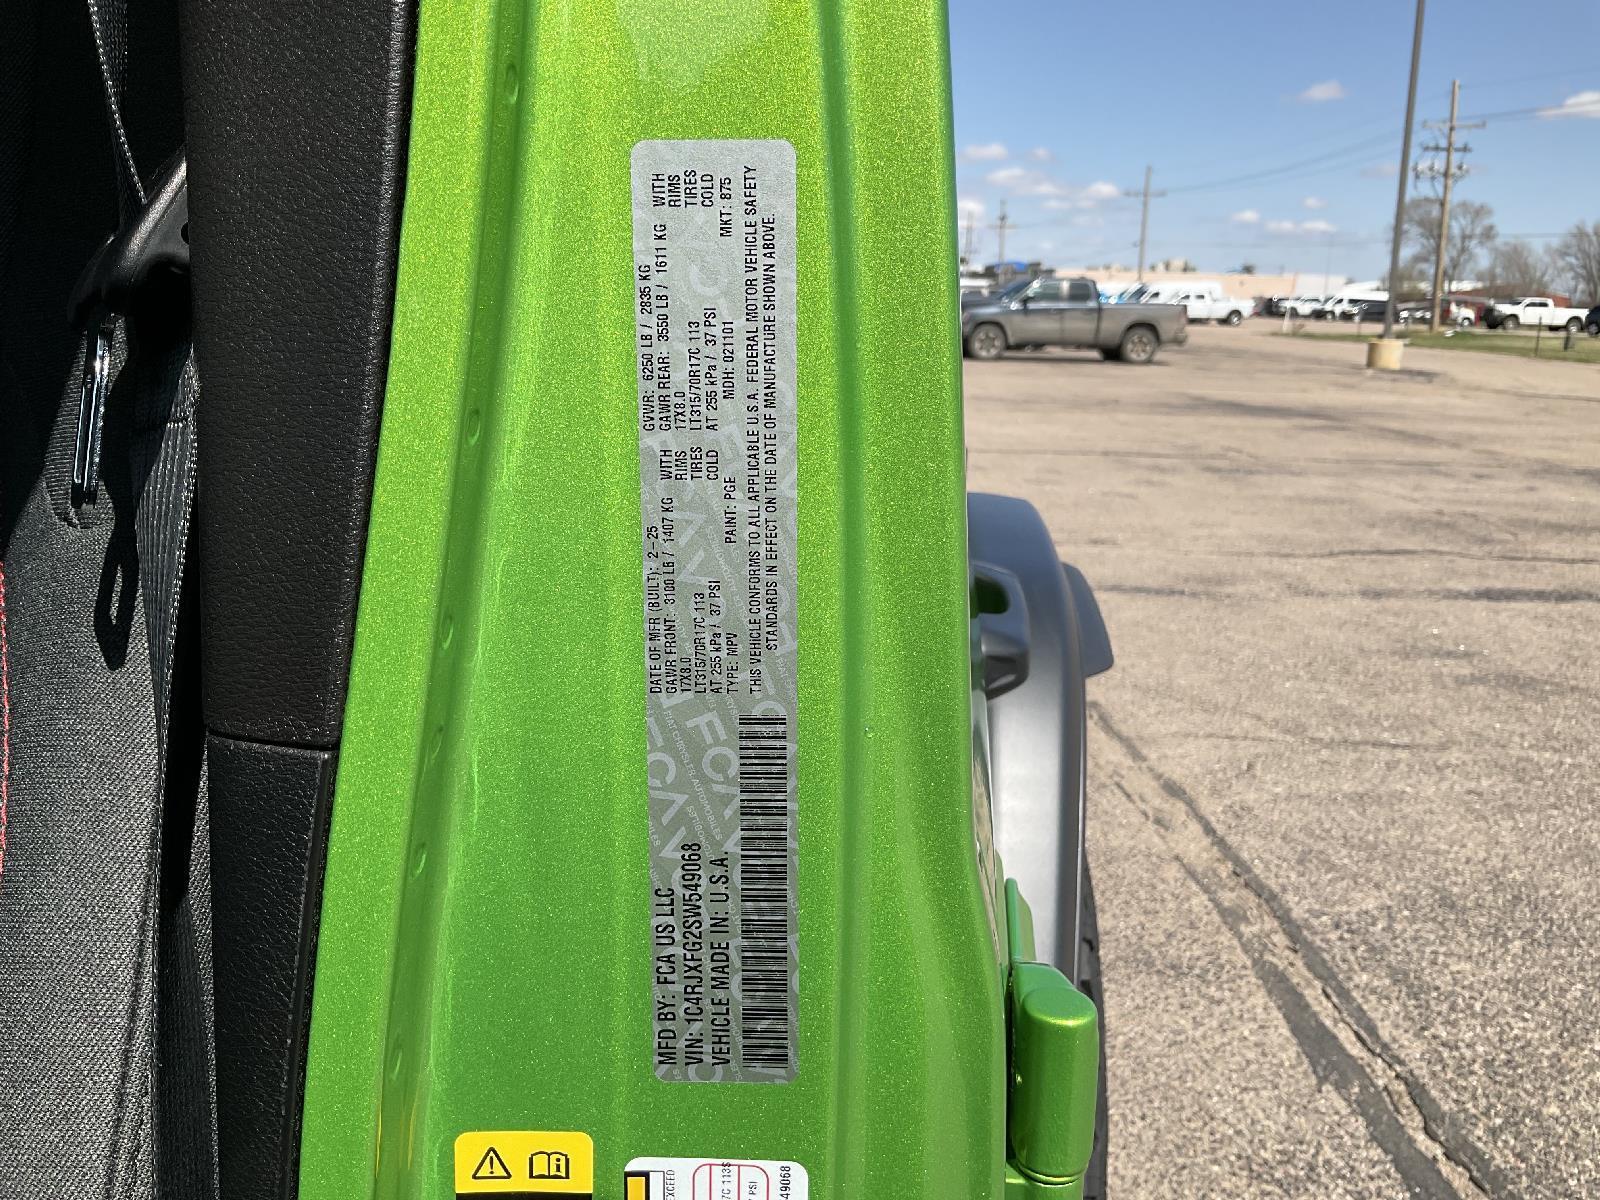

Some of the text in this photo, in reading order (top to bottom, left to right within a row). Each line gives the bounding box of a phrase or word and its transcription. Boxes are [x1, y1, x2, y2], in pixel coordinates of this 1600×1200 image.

[652, 174, 665, 207] WITH
[668, 175, 681, 207] RIMS
[684, 170, 697, 208] TIRES
[701, 174, 714, 207] COLD
[720, 177, 732, 237] MKT: 875
[654, 224, 666, 240] KG
[638, 264, 651, 280] KG
[655, 248, 667, 274] 1611
[640, 286, 652, 314] 2835
[656, 295, 668, 308] LB
[657, 314, 669, 342] 3550
[704, 308, 716, 327] PSI
[641, 334, 652, 347] LB
[704, 332, 716, 346] 37
[642, 354, 654, 381] 6250
[657, 352, 670, 389] REAR:
[688, 321, 701, 430] LT315/70R17C 113
[705, 365, 717, 385] kPa
[722, 322, 734, 399] MDH: 021101
[643, 391, 655, 431] GVWR:
[658, 395, 671, 431] GAWR
[674, 392, 686, 431] 17X8.0
[706, 391, 717, 411] 255
[706, 416, 718, 431] AT
[744, 166, 761, 694] THIS VEHICLE CONFORMS TO ALL APPLICABLE U.S.A. FEDERAL MOTOR VEHICLE SAFETY
[762, 214, 777, 650] STANDARDS IN EFFECT ON THE DATE OF MANUFACTURE SHOWN ABOVE.
[660, 450, 672, 480] WITH
[675, 451, 687, 480] RIMS
[690, 447, 702, 481] TIRES
[706, 450, 718, 480] COLD
[661, 498, 673, 512] KG
[724, 477, 736, 543] PAINT: PGE
[662, 517, 674, 544] 1407
[663, 562, 674, 575] LB
[647, 568, 662, 611] (BUILT):
[708, 581, 720, 598] PSI
[710, 603, 720, 616] 37
[649, 617, 660, 641] MFR
[664, 614, 676, 654] FRONT:
[694, 593, 706, 693] LT315/70R17C 113
[710, 633, 721, 652] kPa
[649, 647, 661, 660] OF
[710, 656, 721, 675] 255
[726, 633, 738, 694] TYPE: MPV
[650, 665, 662, 693] DATE
[665, 660, 677, 693] GAWR
[680, 657, 691, 693] 17X8.0
[710, 680, 722, 693] AT
[681, 842, 703, 1024] 1C4RJXFG2SW549068
[709, 852, 730, 1066] VEHICLE MADE IN: U.S.A.
[655, 888, 677, 1064] MFD BY: FCA US LLC
[685, 1033, 703, 1066] VIN:
[748, 1181, 758, 1196] PSI
[779, 1165, 790, 1200] 49068
